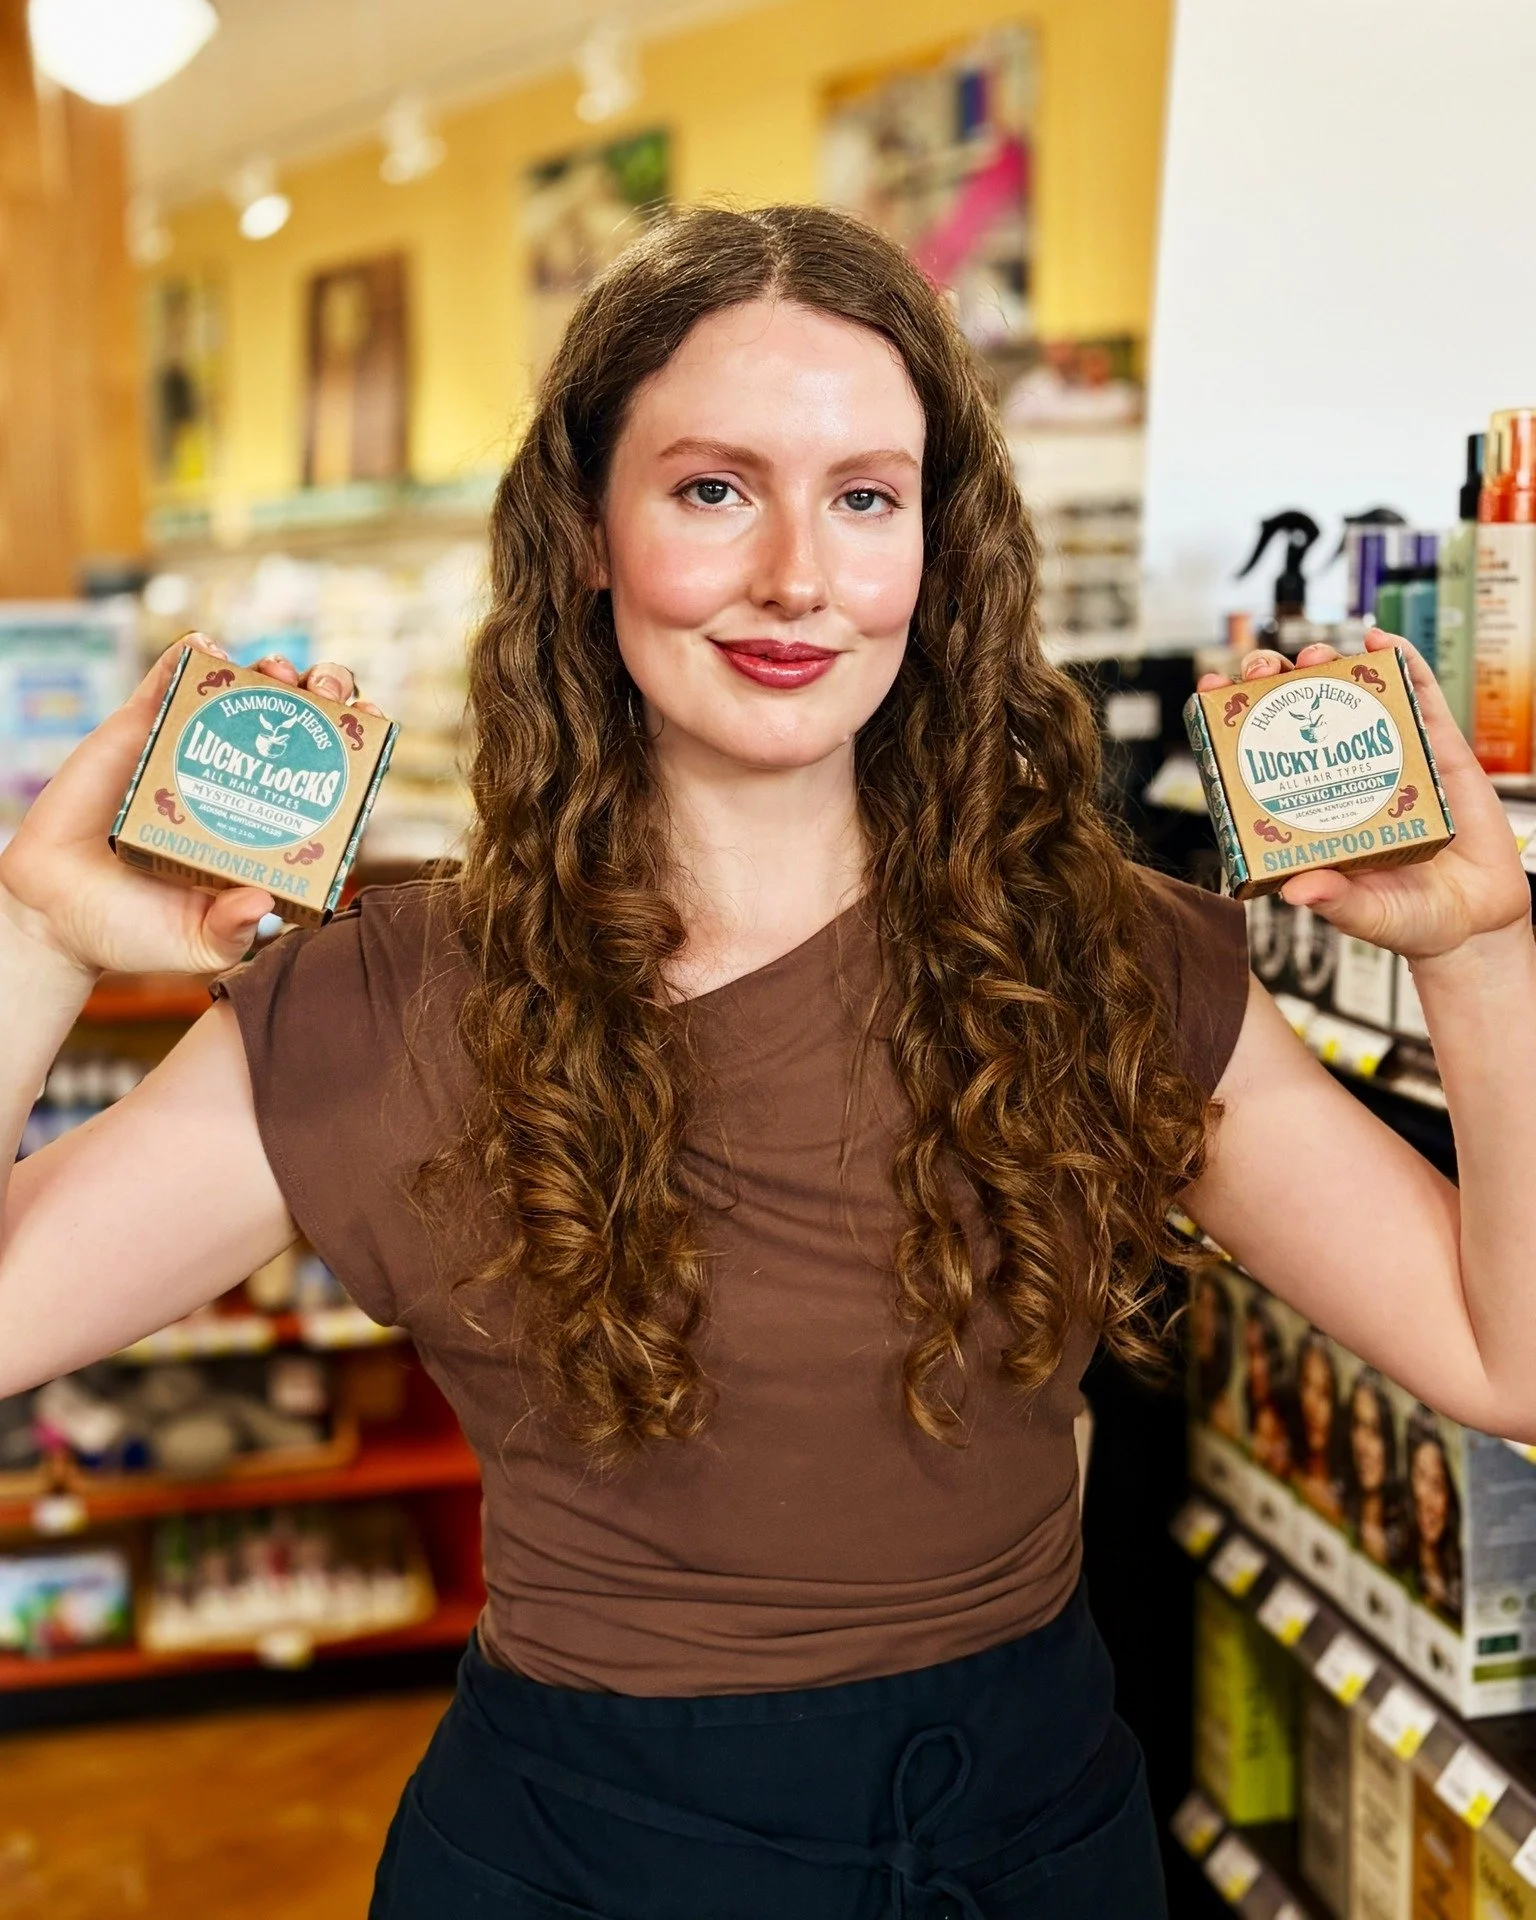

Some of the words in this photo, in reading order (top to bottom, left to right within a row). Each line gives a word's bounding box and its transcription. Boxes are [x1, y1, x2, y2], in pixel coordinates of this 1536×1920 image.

[220, 696, 296, 718] HAMMOND
[298, 708, 332, 750] HERBS
[1252, 687, 1314, 730] HAMMOND
[1318, 684, 1362, 710] HERBS
[184, 720, 263, 780] LUCKY
[259, 763, 341, 807] LOCKS
[1245, 748, 1318, 784] LUCKY
[1322, 718, 1394, 768] LOCKS
[202, 769, 222, 783] ALL
[229, 777, 259, 795] HAIR
[264, 790, 299, 810] TYPES
[1278, 788, 1330, 809] MYSTIC
[1332, 776, 1386, 796] LAGOON
[1279, 781, 1298, 792] ALL
[1305, 772, 1332, 786] HAIR
[1337, 762, 1372, 778] TYPES
[192, 783, 245, 808] MYSTIC
[248, 804, 303, 830] LAGOON
[229, 814, 261, 828] KENTUCKY
[1325, 801, 1354, 811] KENTUCKY
[139, 824, 267, 883] CONDITIONER
[269, 867, 310, 898] BAR
[1262, 830, 1374, 872] SHAMPOO
[1379, 818, 1429, 846] BAR
